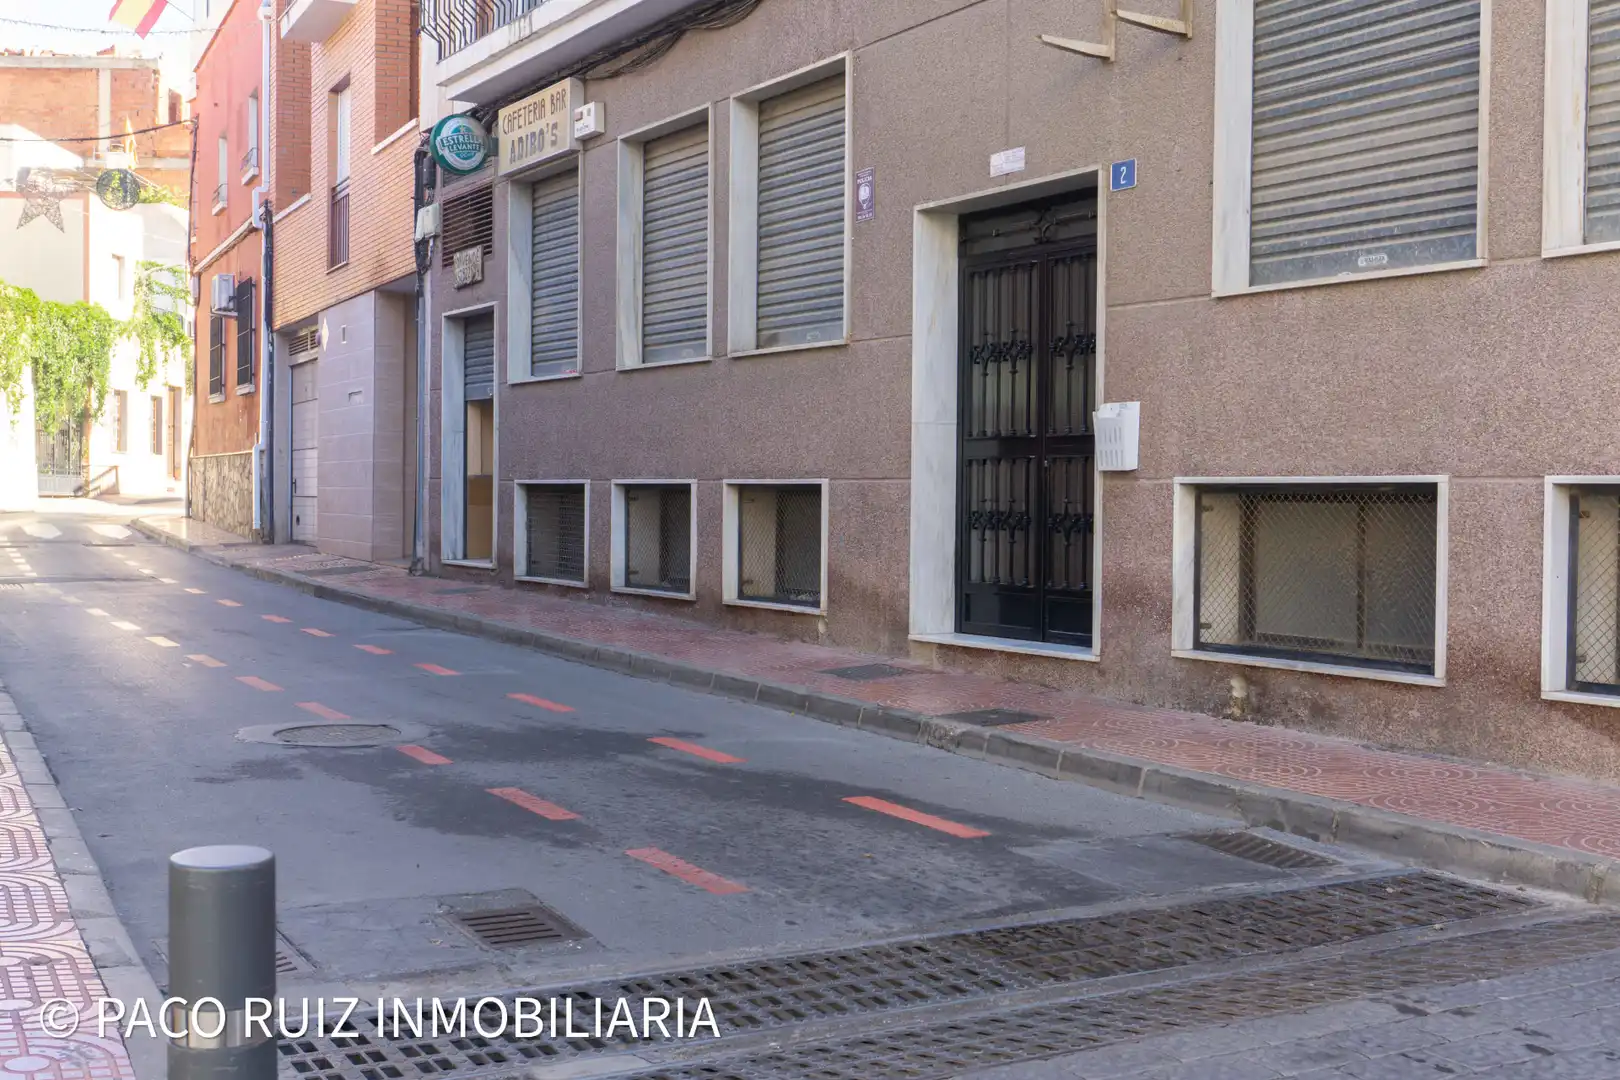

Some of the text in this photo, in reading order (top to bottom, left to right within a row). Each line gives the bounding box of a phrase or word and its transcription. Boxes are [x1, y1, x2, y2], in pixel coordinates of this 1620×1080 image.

[502, 88, 567, 135] CAFETERIA BAR
[449, 143, 480, 152] LEVANTE
[1119, 166, 1127, 184] 2
